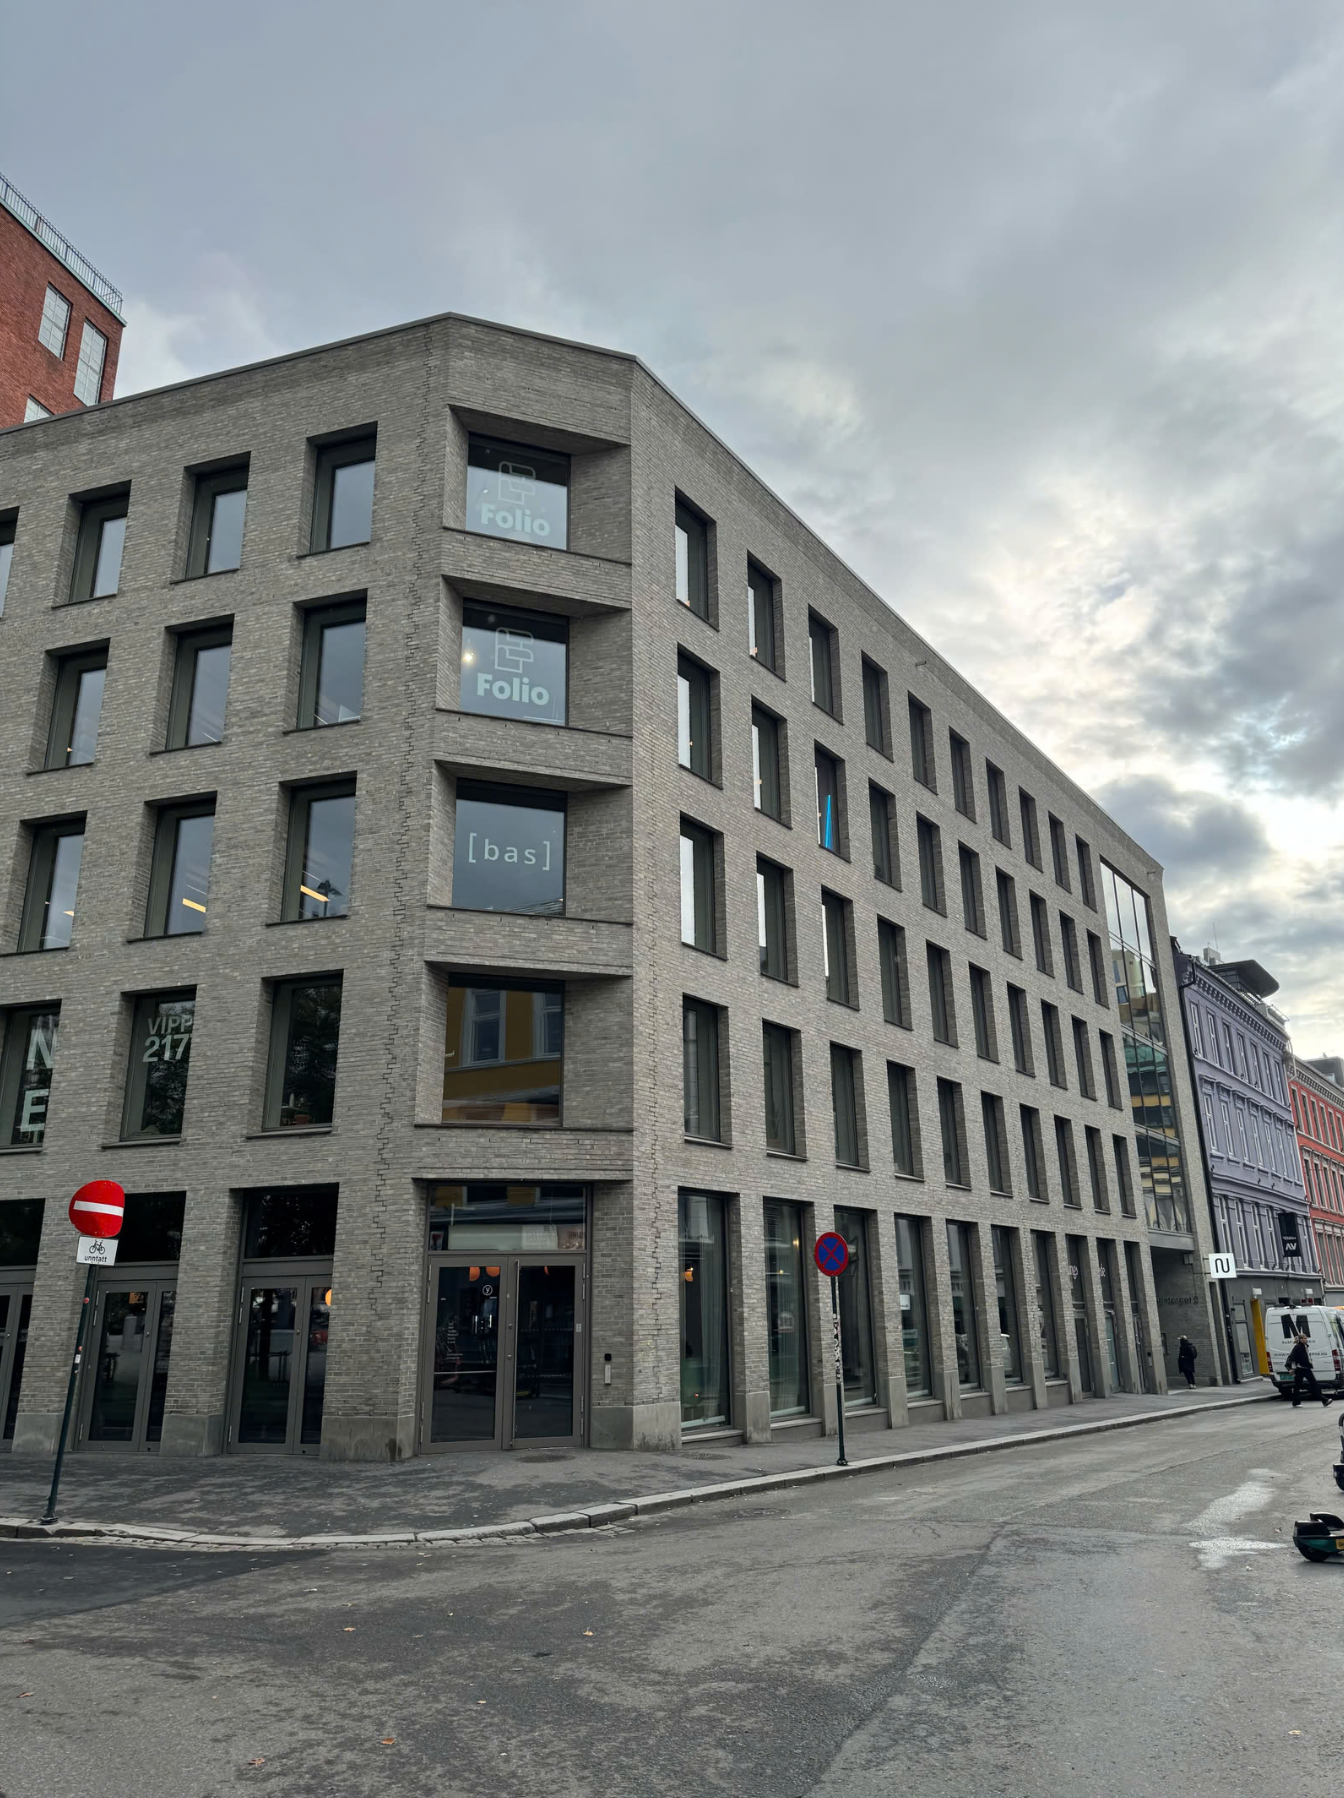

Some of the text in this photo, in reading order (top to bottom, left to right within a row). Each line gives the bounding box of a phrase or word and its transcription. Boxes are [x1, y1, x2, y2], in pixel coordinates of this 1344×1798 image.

[480, 502, 551, 538] Folio
[476, 672, 550, 707] Folio
[20, 1088, 49, 1132] E
[84, 1255, 108, 1263] unntatt
